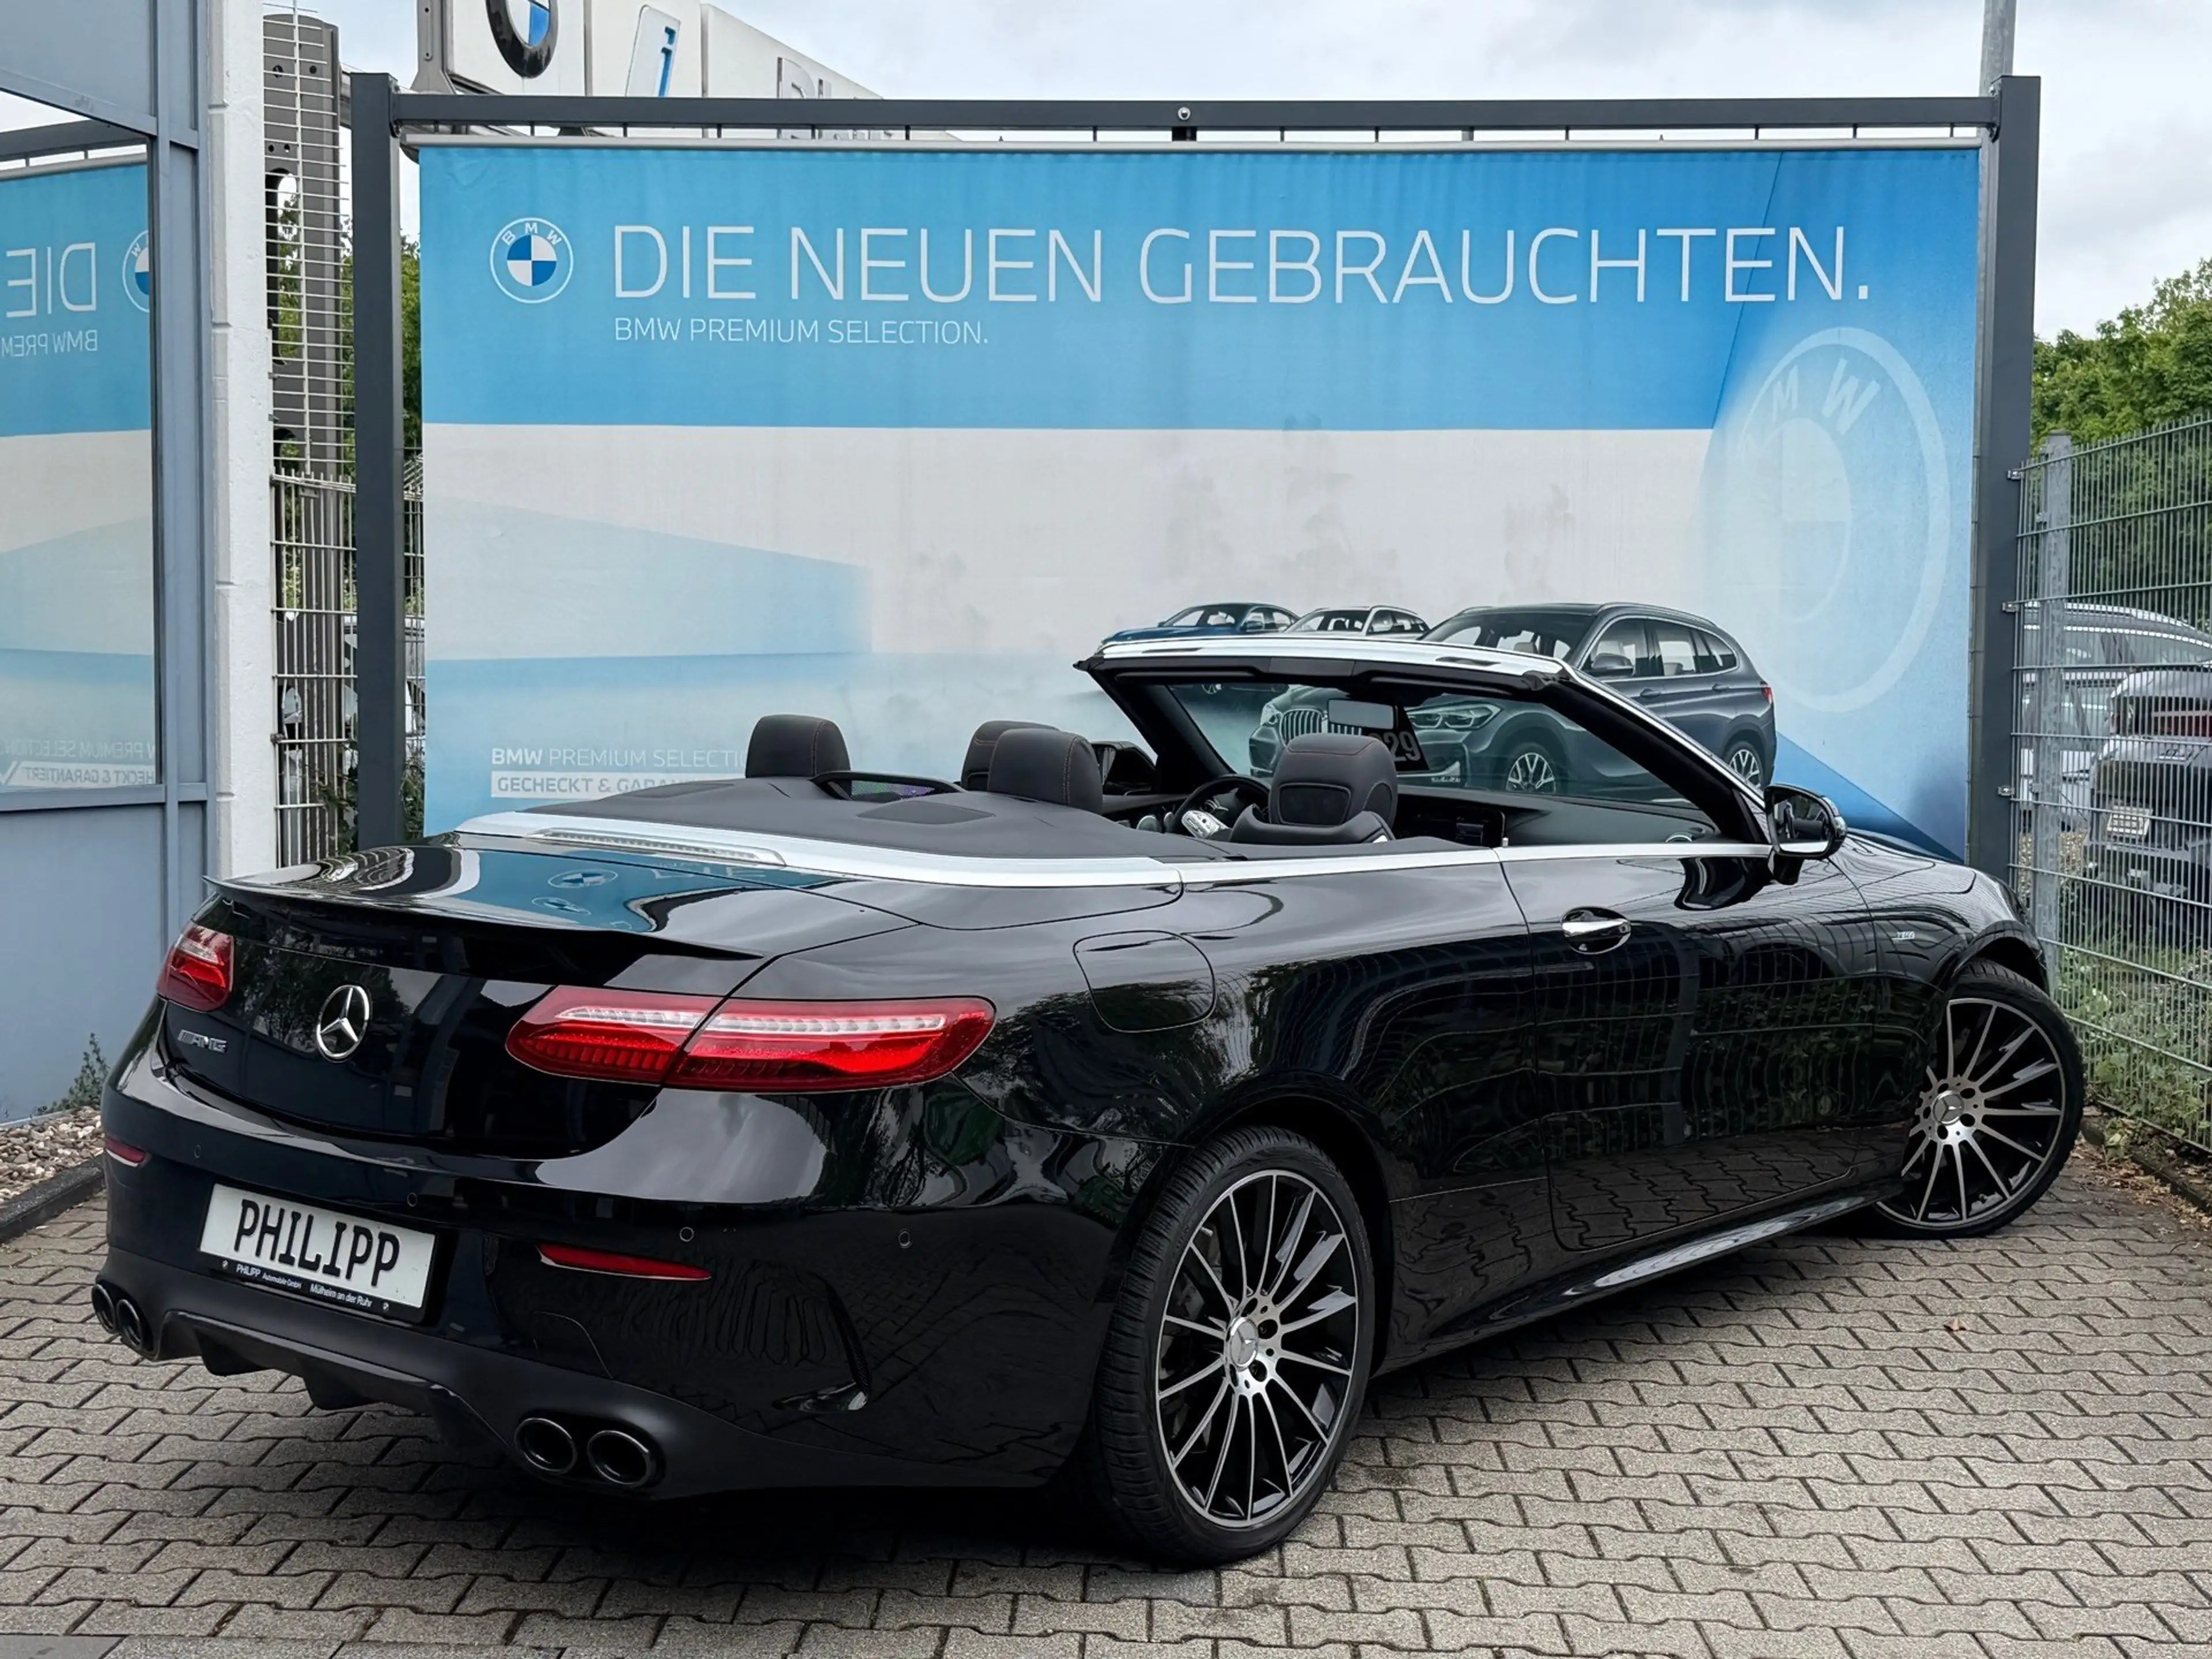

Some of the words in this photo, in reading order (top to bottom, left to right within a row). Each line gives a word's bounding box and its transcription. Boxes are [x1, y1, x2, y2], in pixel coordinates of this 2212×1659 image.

[501, 222, 562, 247] BMW
[614, 225, 756, 300] DIE
[791, 227, 1101, 303] NEUEN
[1139, 226, 1869, 304] GEBRAUCHTEN.
[615, 317, 681, 341] BMW
[690, 318, 819, 343] PREMIUM
[828, 319, 988, 344] SELECTION.
[491, 748, 543, 766] BMW
[549, 748, 646, 767] PREMIUM
[653, 749, 747, 768] SELECTI
[1368, 731, 1421, 761] 29
[497, 777, 593, 793] GECHECKT
[597, 778, 612, 793] &
[233, 1198, 400, 1288] PHILIPP
[236, 1263, 261, 1278] PHILIPP
[310, 1283, 337, 1299] Mülheim
[337, 1292, 345, 1300] an
[346, 1293, 357, 1303] der
[357, 1295, 373, 1308] Ruhr
